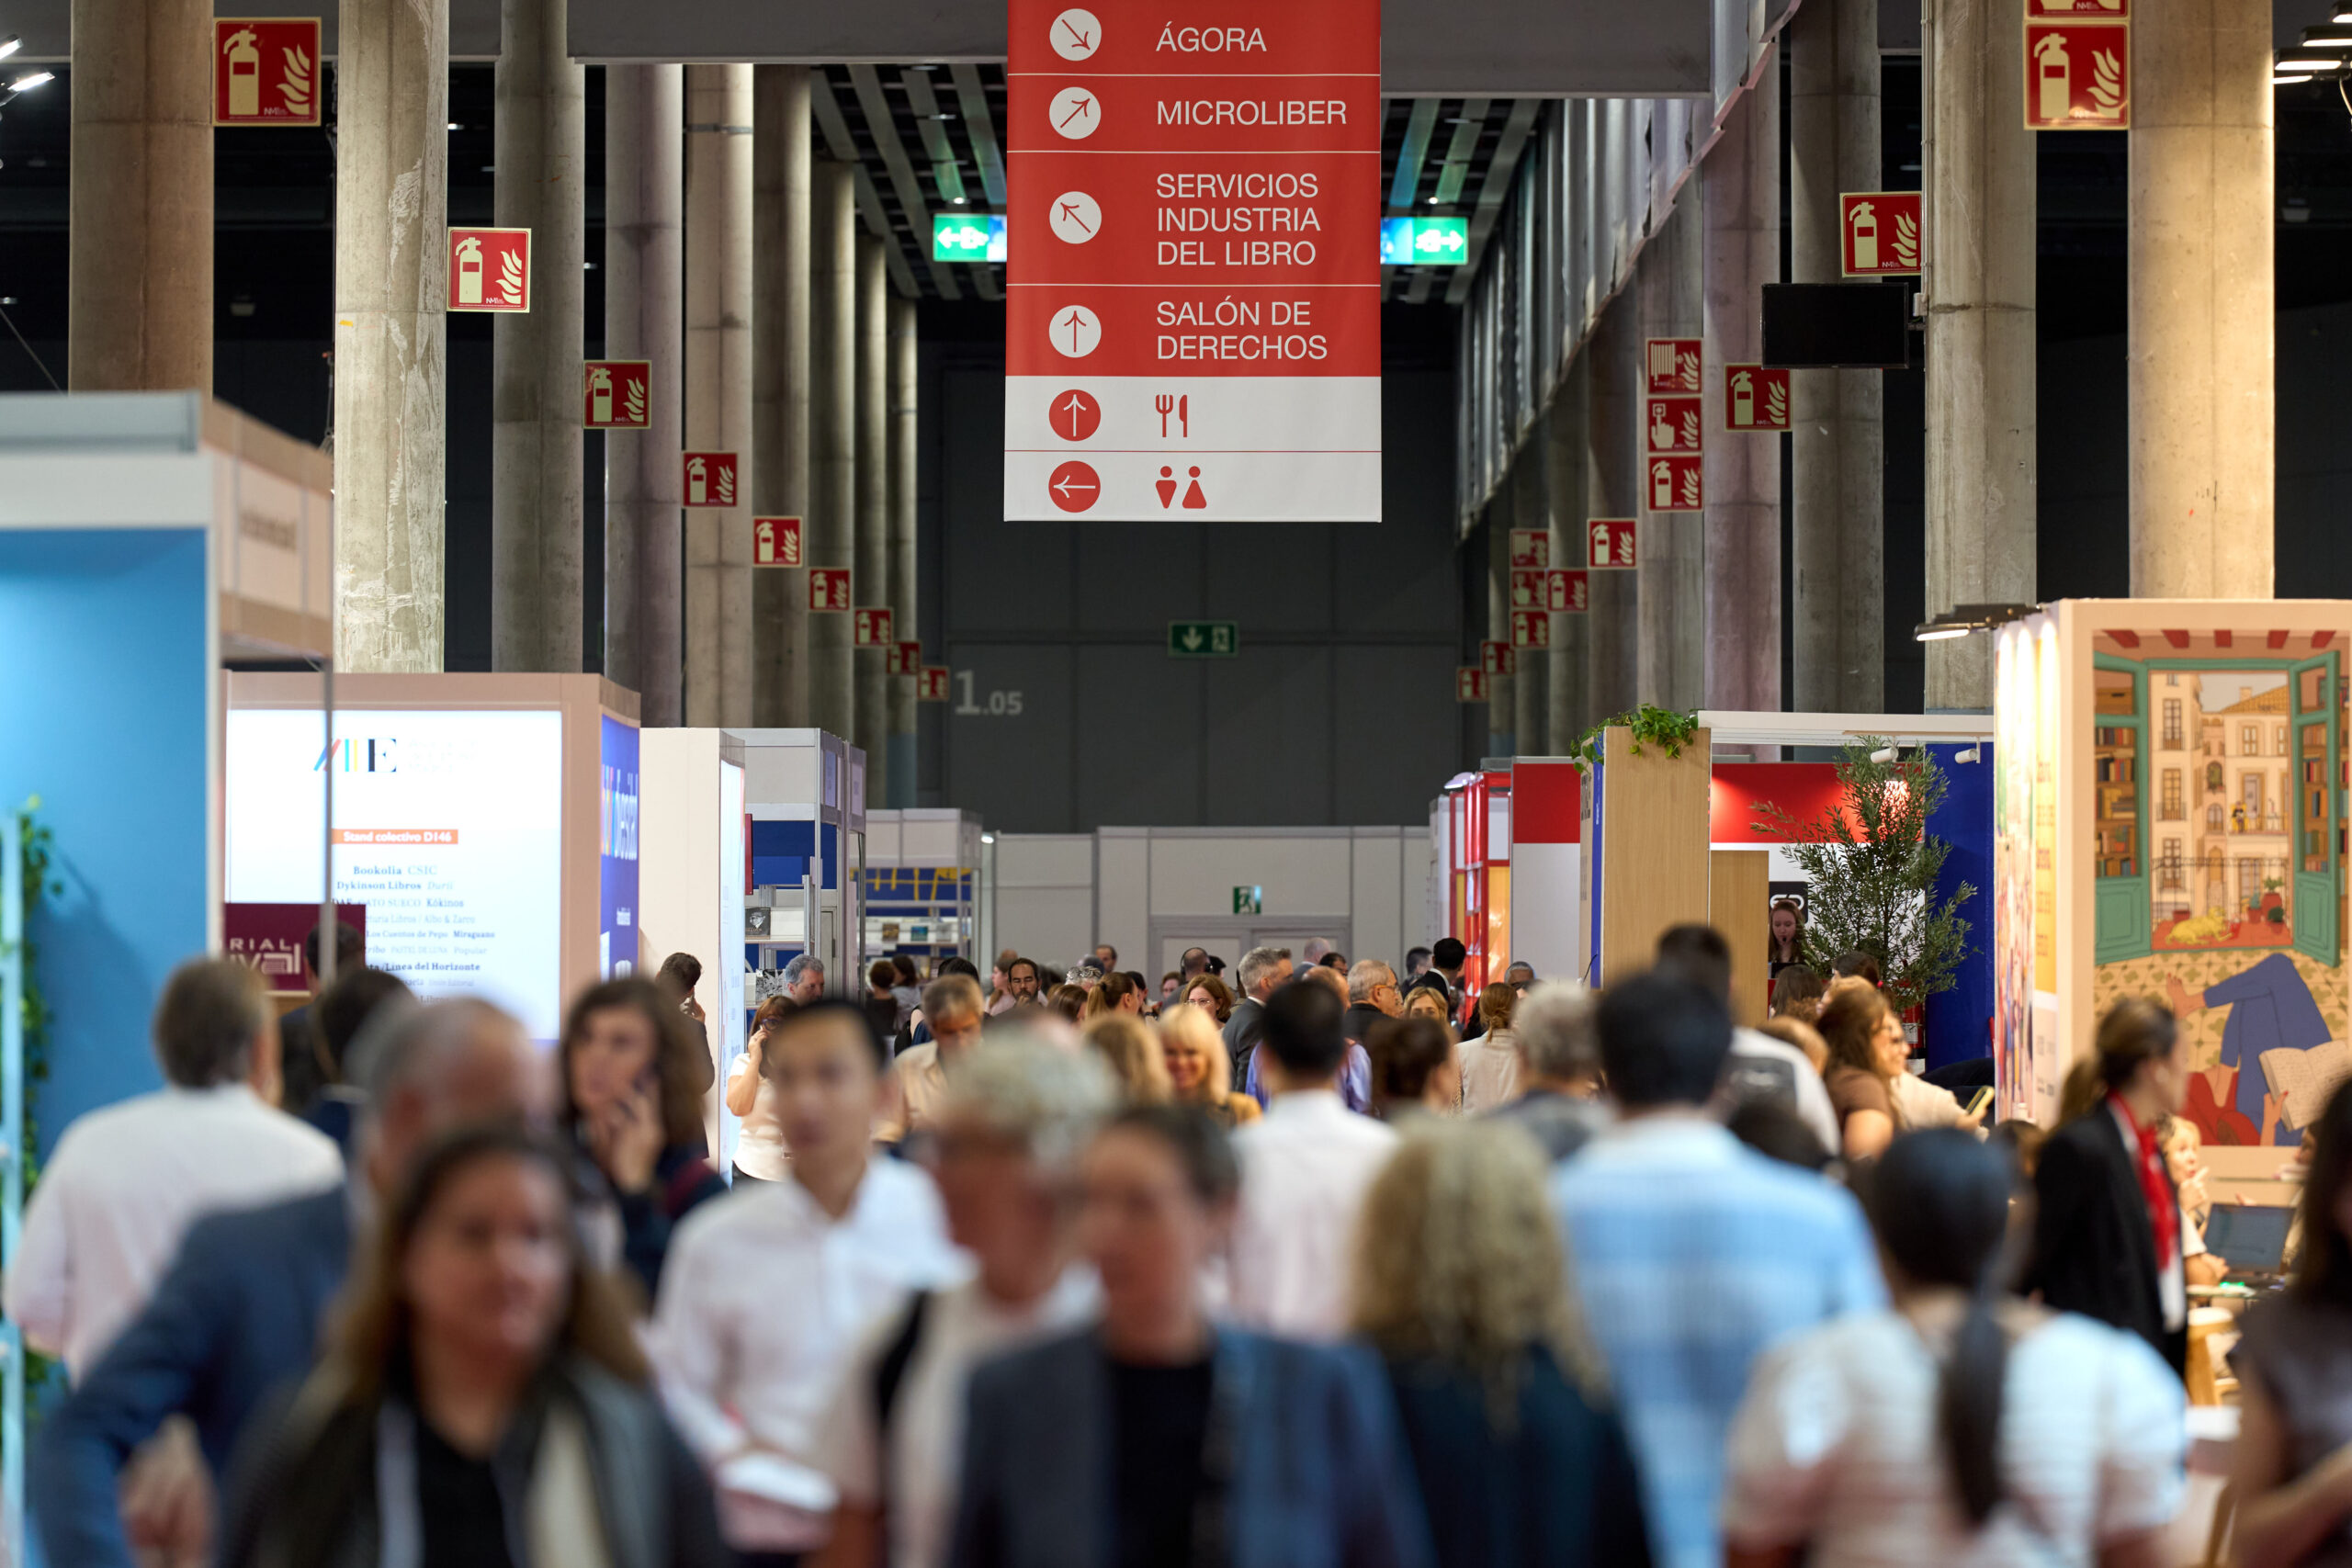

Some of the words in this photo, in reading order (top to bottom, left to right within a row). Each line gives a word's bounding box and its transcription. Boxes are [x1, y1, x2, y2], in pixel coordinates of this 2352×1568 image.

[1156, 21, 1267, 52] ÁGORA
[1157, 100, 1347, 125] MICROLIBER
[1156, 173, 1318, 198] SERVICIOS
[1158, 207, 1321, 232] INDUSTRIA
[1158, 241, 1216, 265] DEL
[1226, 240, 1317, 266] LIBRO
[1156, 295, 1260, 327] SALÓN
[1271, 300, 1311, 326] DE
[1158, 334, 1328, 360] DERECHOS
[344, 831, 373, 842] Stand
[376, 831, 422, 842] colectivo
[424, 831, 452, 842] D146
[353, 865, 402, 875] Bookolia
[407, 865, 438, 875] CSIC
[336, 880, 385, 892] Dykinson
[387, 880, 422, 890] Libros
[414, 962, 429, 971] del
[431, 962, 481, 971] Horizonte
